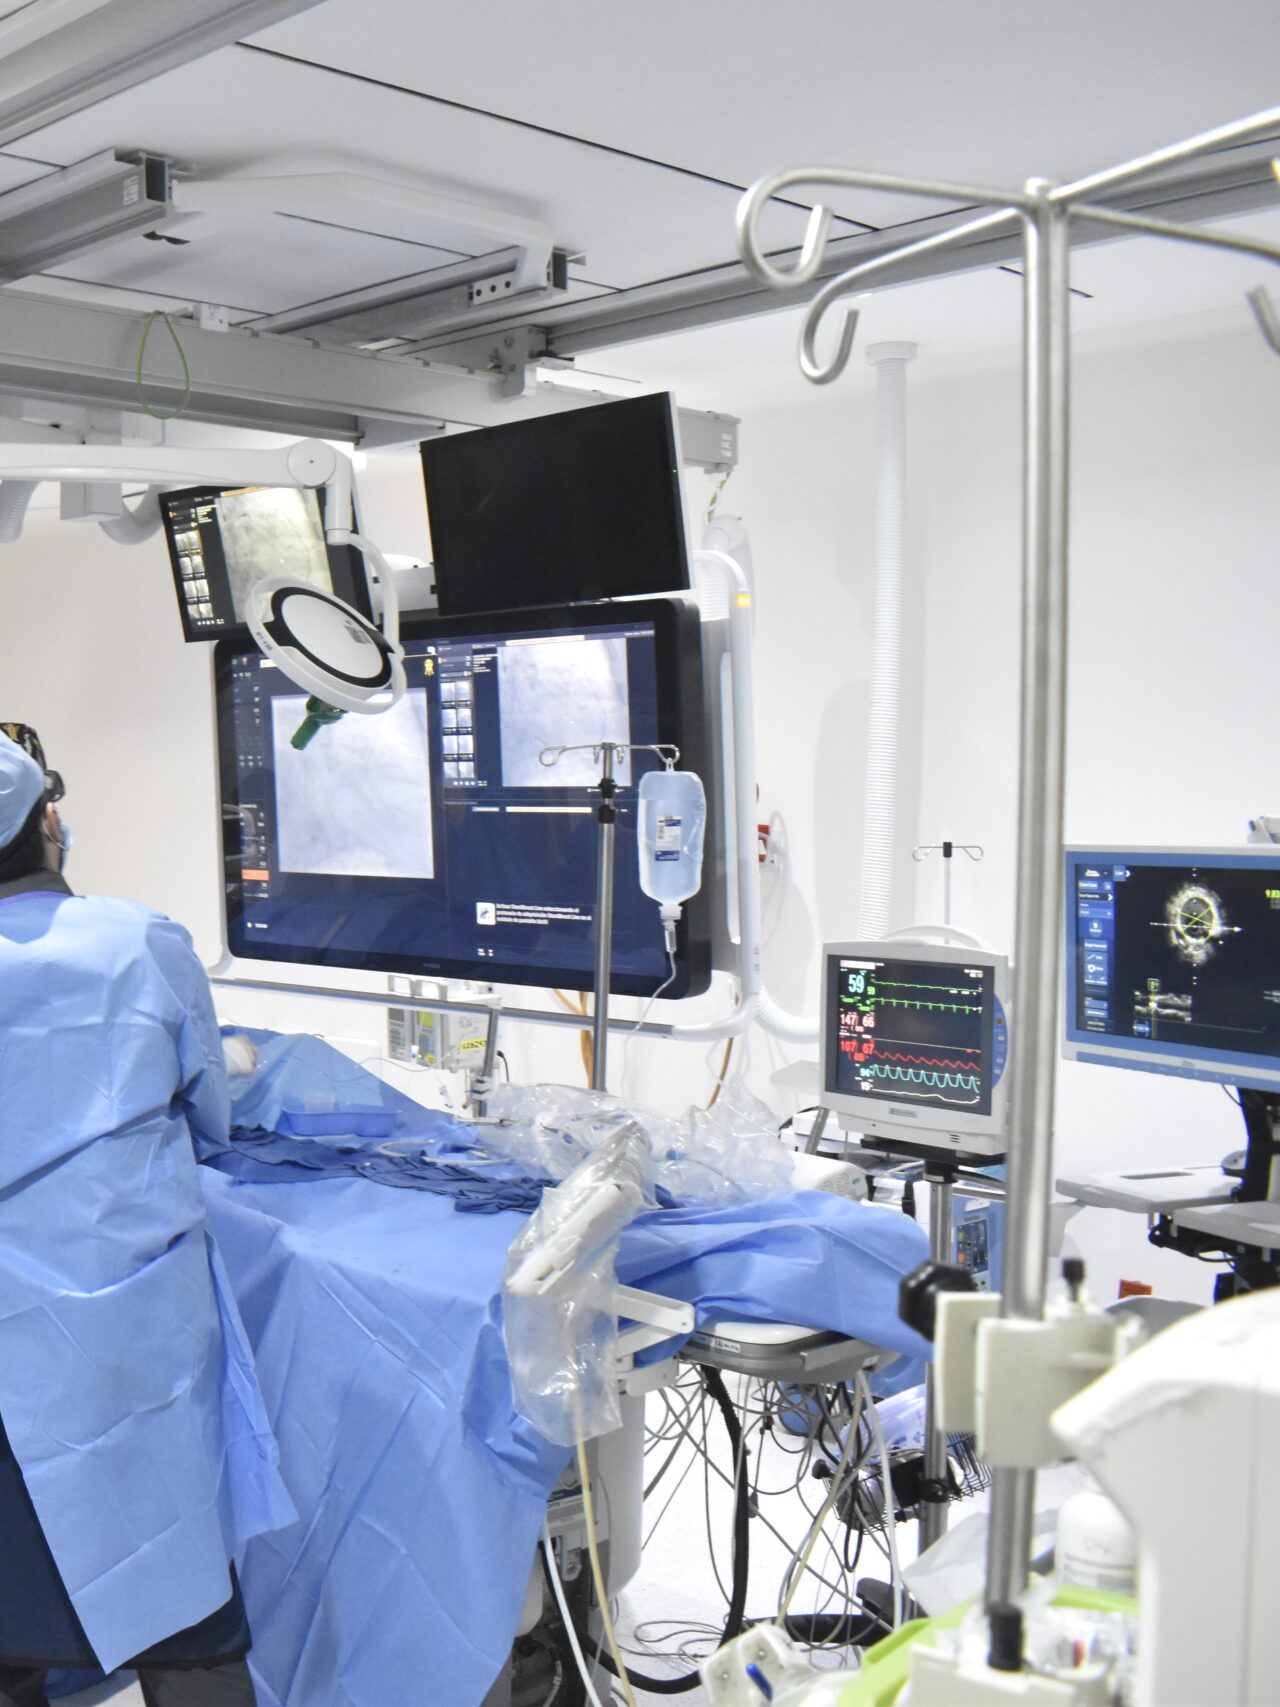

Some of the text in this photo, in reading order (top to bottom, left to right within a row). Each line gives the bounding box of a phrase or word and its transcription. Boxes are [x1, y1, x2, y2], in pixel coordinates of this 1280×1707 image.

[848, 974, 865, 993] 59
[862, 1016, 875, 1028] 66
[862, 1043, 875, 1054] 67
